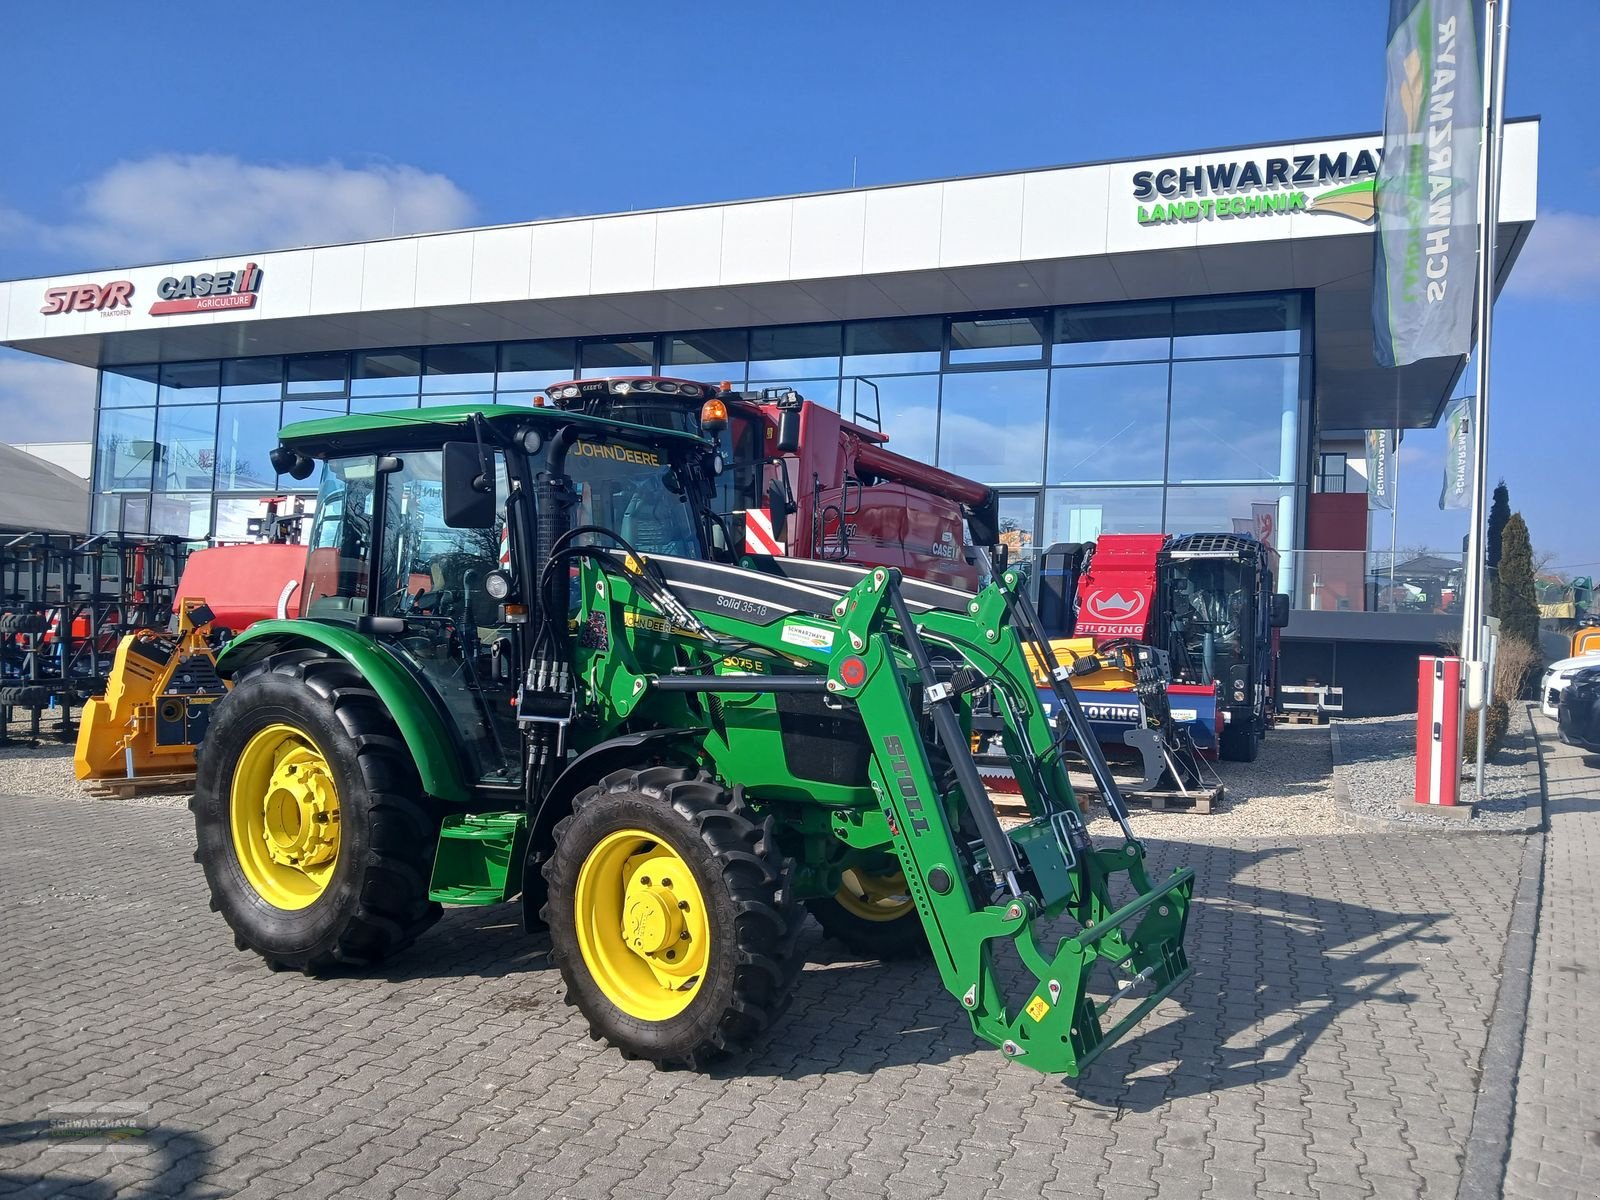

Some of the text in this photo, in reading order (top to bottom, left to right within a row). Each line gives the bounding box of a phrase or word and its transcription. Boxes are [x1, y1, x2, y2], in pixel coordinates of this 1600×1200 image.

[1133, 148, 1384, 198] SCHWARZMA
[1137, 191, 1307, 224] LANDTECHNIK
[157, 271, 235, 300] CASE
[40, 280, 135, 314] STEYR
[196, 295, 250, 309] AGRICULTURE
[100, 309, 131, 318] TRAKTOREN
[932, 542, 952, 558] CASE
[716, 595, 768, 617] Solid 35-18
[1075, 624, 1144, 634] SILOKING
[1082, 705, 1139, 721] LOKING
[882, 735, 931, 838] STOLL
